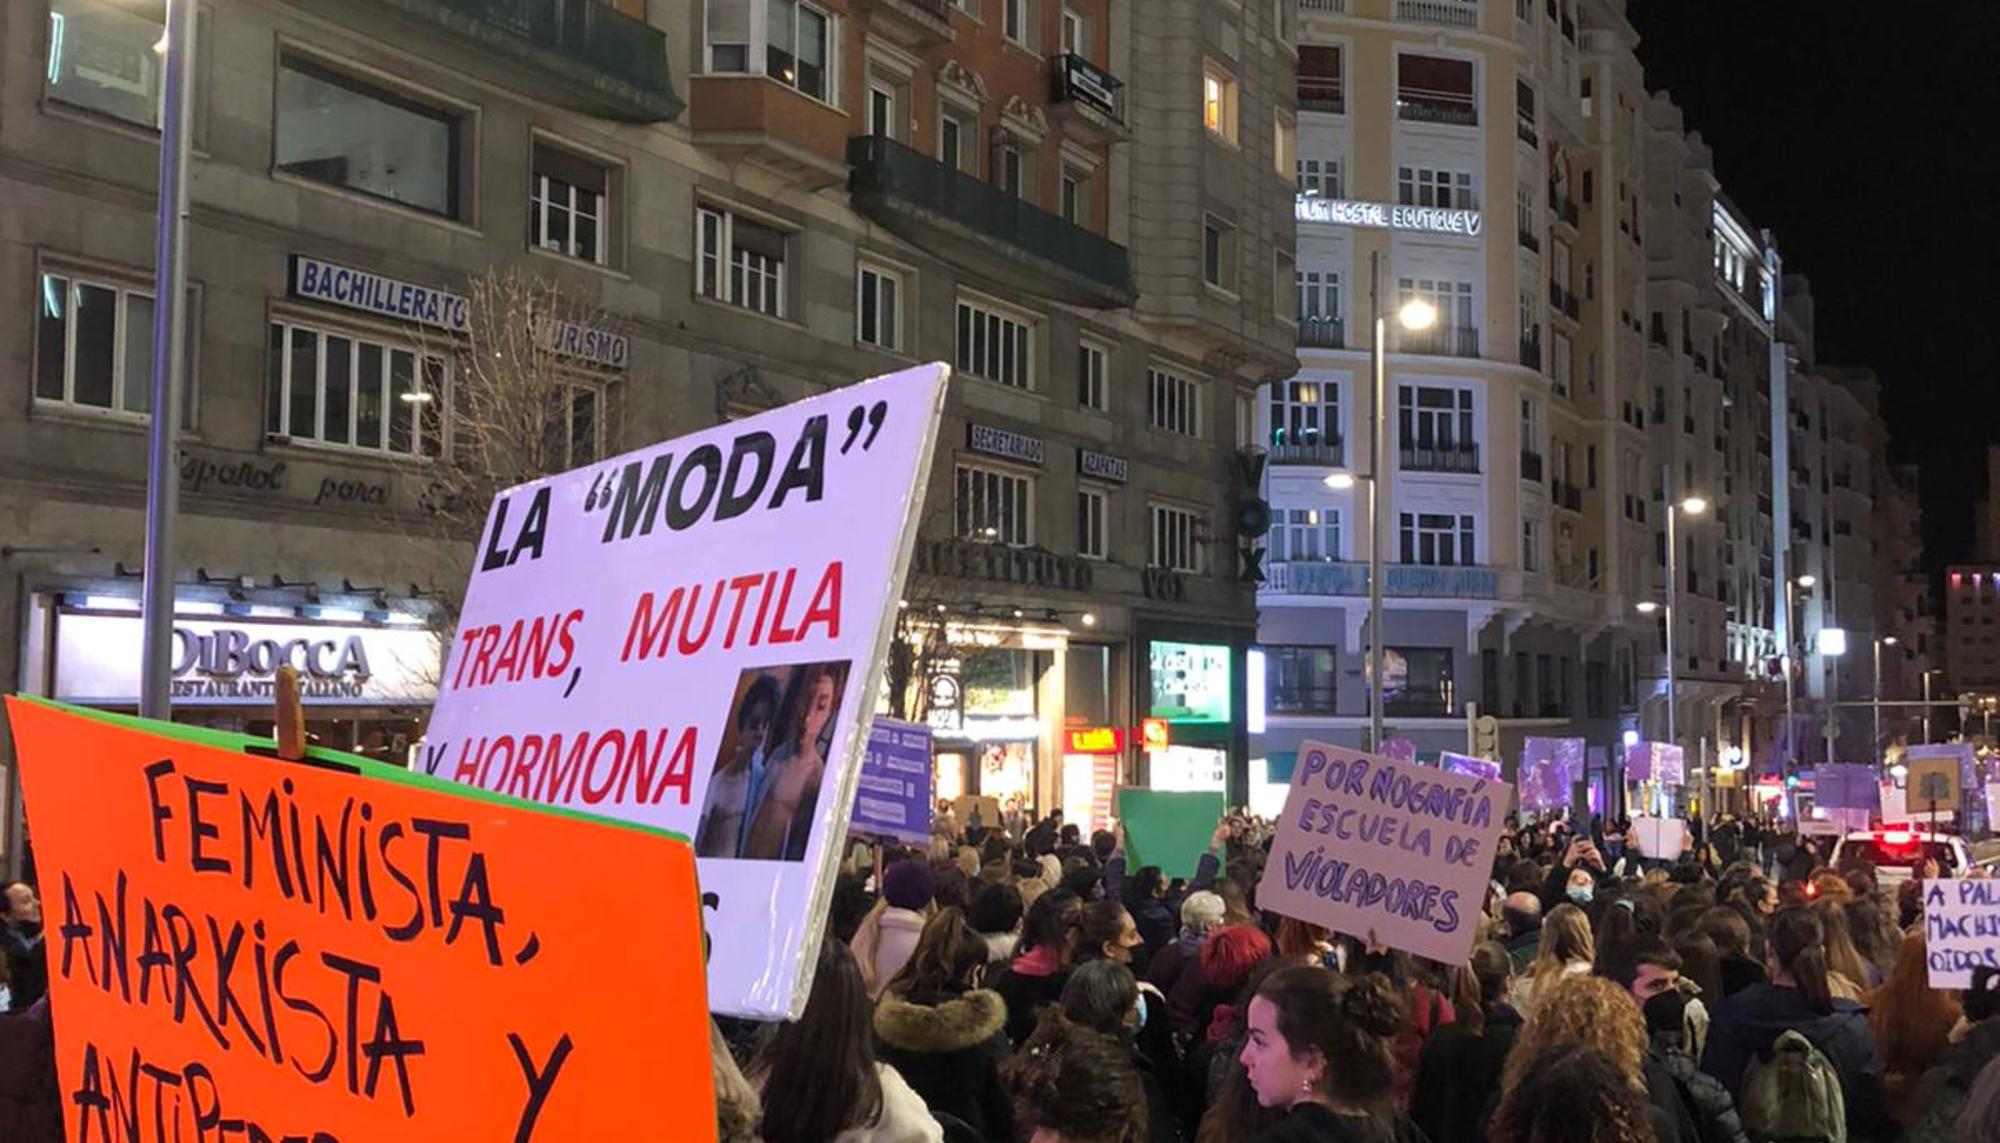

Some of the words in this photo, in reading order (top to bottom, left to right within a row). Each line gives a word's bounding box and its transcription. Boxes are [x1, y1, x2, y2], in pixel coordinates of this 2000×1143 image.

[1332, 201, 1390, 226] HOSTAL
[302, 261, 467, 332] BACHILLERATO
[550, 318, 625, 365] URISMO
[481, 485, 552, 573] LA
[452, 607, 584, 699] TRANS,
[620, 561, 845, 663] MUTILA
[170, 679, 277, 697] ESTAURANT
[297, 681, 363, 698] TALIANO
[453, 726, 698, 806] HORMONA
[1298, 798, 1431, 857] ESCUELA
[1445, 836, 1480, 867] DE
[1927, 883, 1945, 907] A
[1959, 880, 2000, 906] PAL
[1928, 913, 2000, 943] MACHI
[507, 1033, 574, 1143] Y
